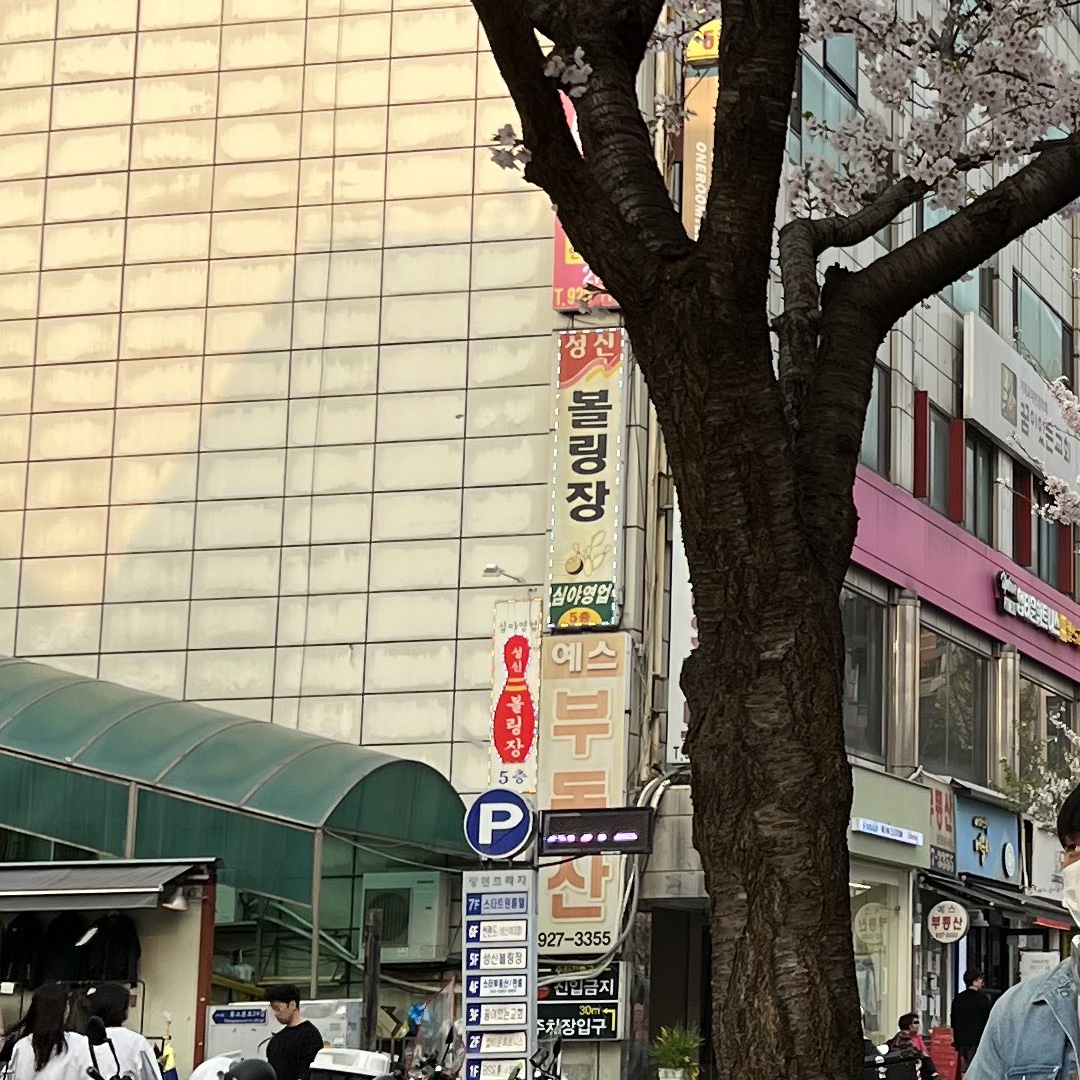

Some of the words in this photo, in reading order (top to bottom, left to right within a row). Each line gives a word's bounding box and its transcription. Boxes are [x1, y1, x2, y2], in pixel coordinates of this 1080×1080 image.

[564, 332, 615, 360] 성신
[565, 388, 613, 522] 볼링장
[551, 583, 613, 606] 심야영업
[551, 641, 617, 672] 예스
[504, 693, 525, 758] 볼링장
[547, 688, 613, 920] 부동산
[477, 802, 525, 845] P
[468, 898, 480, 911] 7F
[931, 916, 962, 930] 부동산
[537, 931, 612, 947] 927-3355
[469, 953, 480, 966] 5F
[469, 980, 479, 993] 4F
[469, 1008, 479, 1021] 3F
[579, 1005, 601, 1016] 30m
[469, 1035, 480, 1049] 2F
[469, 1065, 479, 1078] 1F
